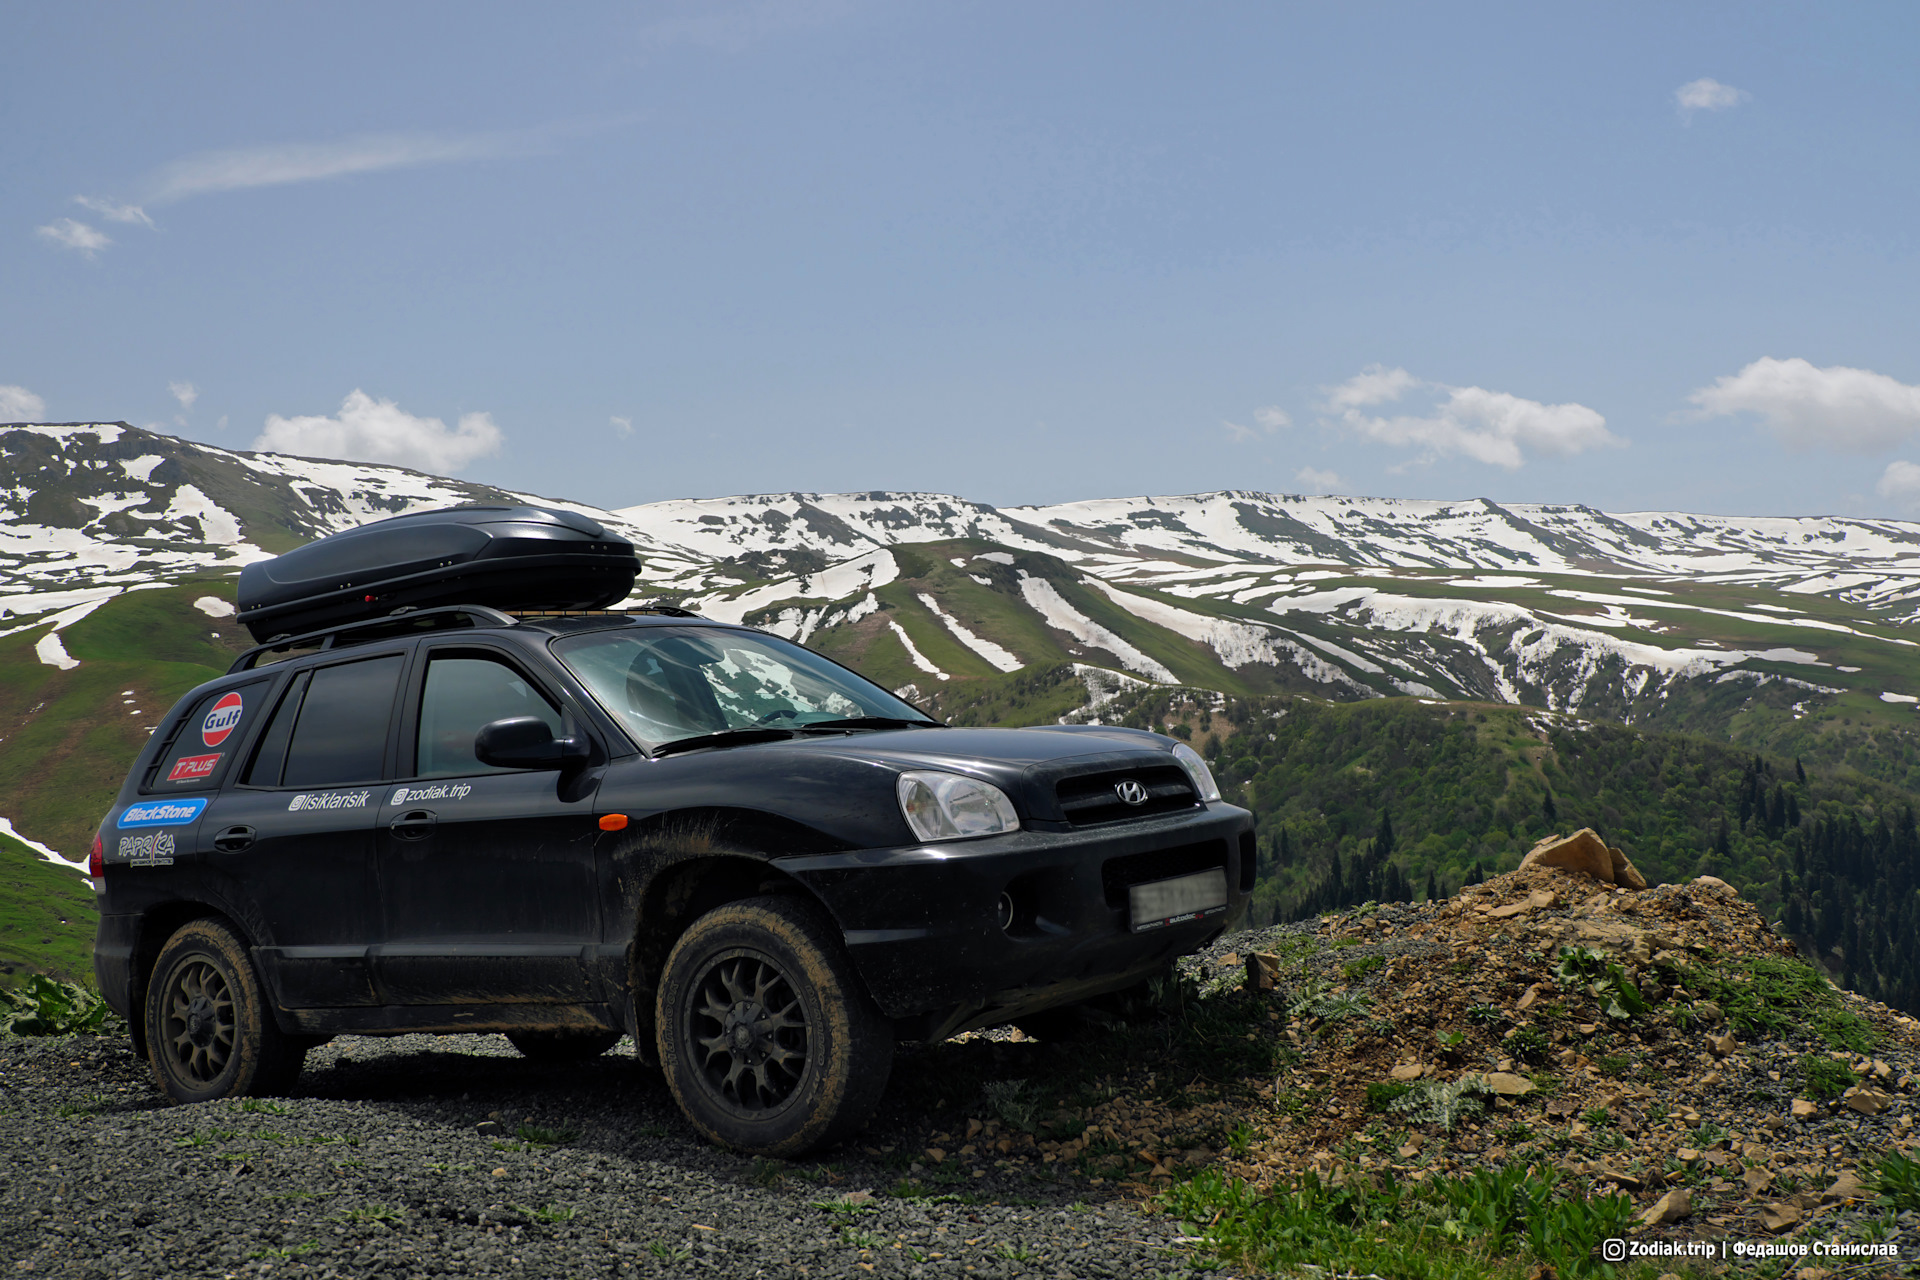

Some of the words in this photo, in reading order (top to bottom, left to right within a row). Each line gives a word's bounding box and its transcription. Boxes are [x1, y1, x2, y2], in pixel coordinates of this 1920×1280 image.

[204, 709, 241, 730] Gulf
[174, 761, 187, 776] T
[184, 758, 216, 774] PLUS
[300, 790, 371, 810] lisiklarisik
[406, 783, 472, 801] zodiak.trip
[123, 804, 197, 823] BlackStone
